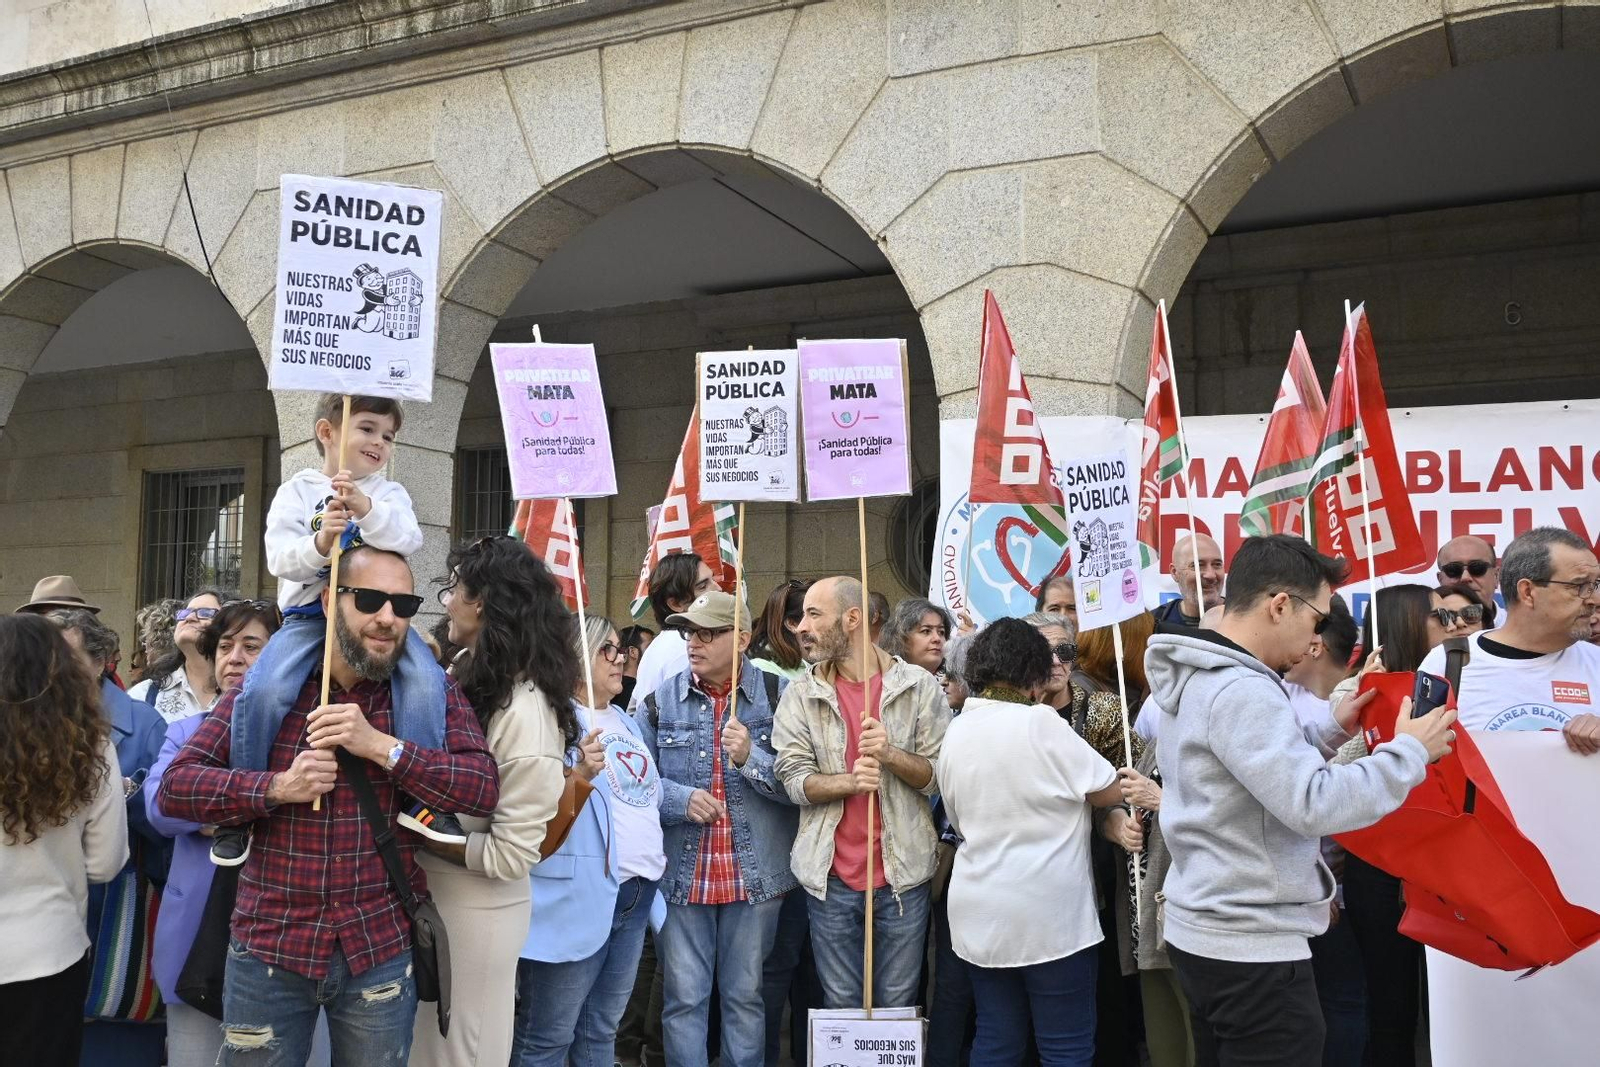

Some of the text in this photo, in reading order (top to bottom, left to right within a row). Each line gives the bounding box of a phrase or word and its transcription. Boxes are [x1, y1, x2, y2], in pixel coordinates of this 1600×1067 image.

[294, 190, 425, 226] SANIDAD
[290, 219, 422, 257] PÚBLICA
[287, 271, 353, 292] NUESTRAS
[286, 291, 323, 308] VIDAS
[284, 309, 350, 330] IMPORTAN
[1505, 302, 1521, 325] 6
[283, 327, 339, 348] MÁS QUE
[281, 348, 371, 371] SUS NEGOCIOS
[504, 368, 591, 382] PRIVATIZAR
[706, 360, 786, 379] SANIDAD
[808, 365, 894, 382] PRIVATIZAR
[527, 385, 575, 400] MATA
[705, 381, 785, 400] PÚBLICA
[829, 383, 877, 400] MATA
[705, 418, 744, 430] NUESTRAS
[522, 436, 596, 449] ¡Sanidad Pública
[705, 432, 727, 443] VIDAS
[818, 436, 893, 451] ¡Sanidad Pública
[535, 446, 585, 457] para todas!
[705, 445, 744, 456] IMPORTAN
[830, 446, 882, 459] para todas!
[705, 457, 738, 469] MÁS QUE
[705, 471, 721, 482] SUS
[721, 471, 759, 482] NEGOCIOS
[1066, 460, 1125, 487] SANIDAD
[1069, 484, 1130, 514] PÚBLICA
[1554, 687, 1581, 696] CCOO
[1488, 706, 1566, 731] MAREA BLAN
[854, 1039, 897, 1051] NEGOCIOS
[899, 1040, 916, 1051] SUS
[877, 1054, 916, 1067] MÁS QUE
